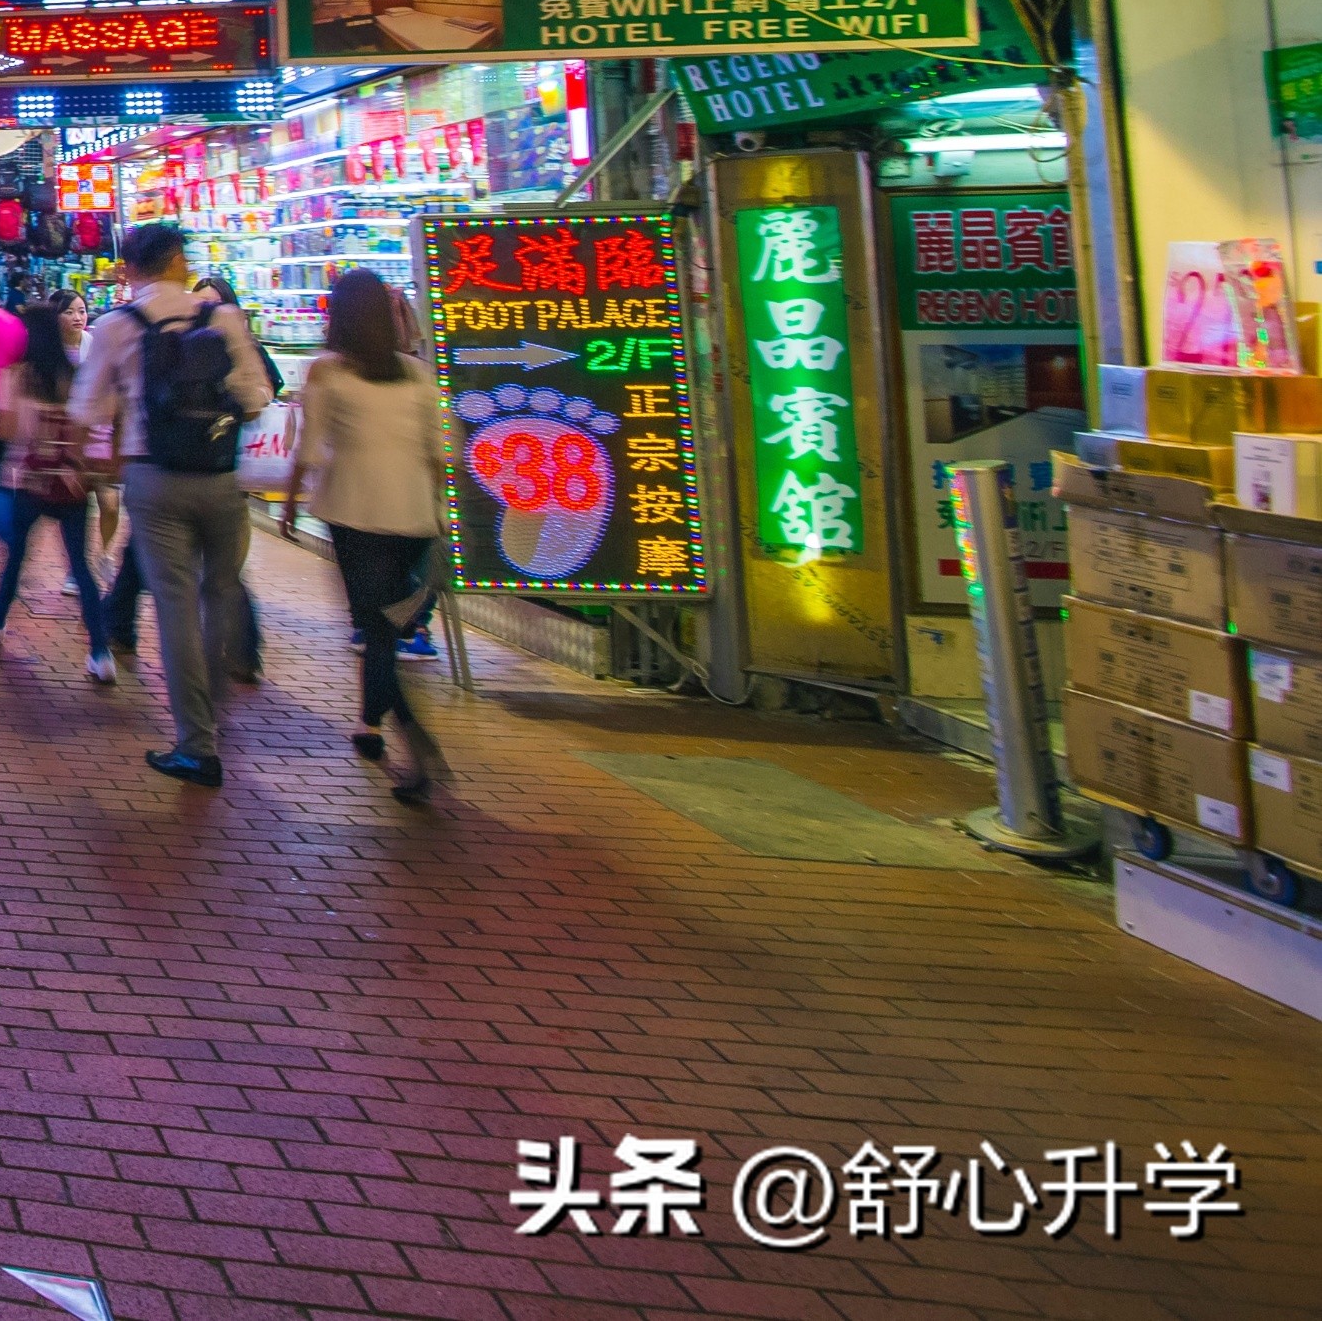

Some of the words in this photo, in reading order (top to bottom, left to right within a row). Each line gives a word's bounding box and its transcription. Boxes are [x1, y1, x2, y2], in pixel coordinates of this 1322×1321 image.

[6, 14, 219, 52] MASSAGE
[540, 19, 674, 47] HOTEL
[702, 16, 810, 41] FREE
[836, 13, 929, 37] WIFI
[705, 78, 825, 123] HOTEL
[444, 300, 535, 331] FOOT
[537, 298, 672, 331] PALACE
[917, 289, 1015, 325] REGENG
[586, 337, 672, 371] 2/F
[752, 210, 857, 550] 麗晶賓館
[472, 431, 601, 512] $38
[623, 384, 690, 577] 正宗按摩
